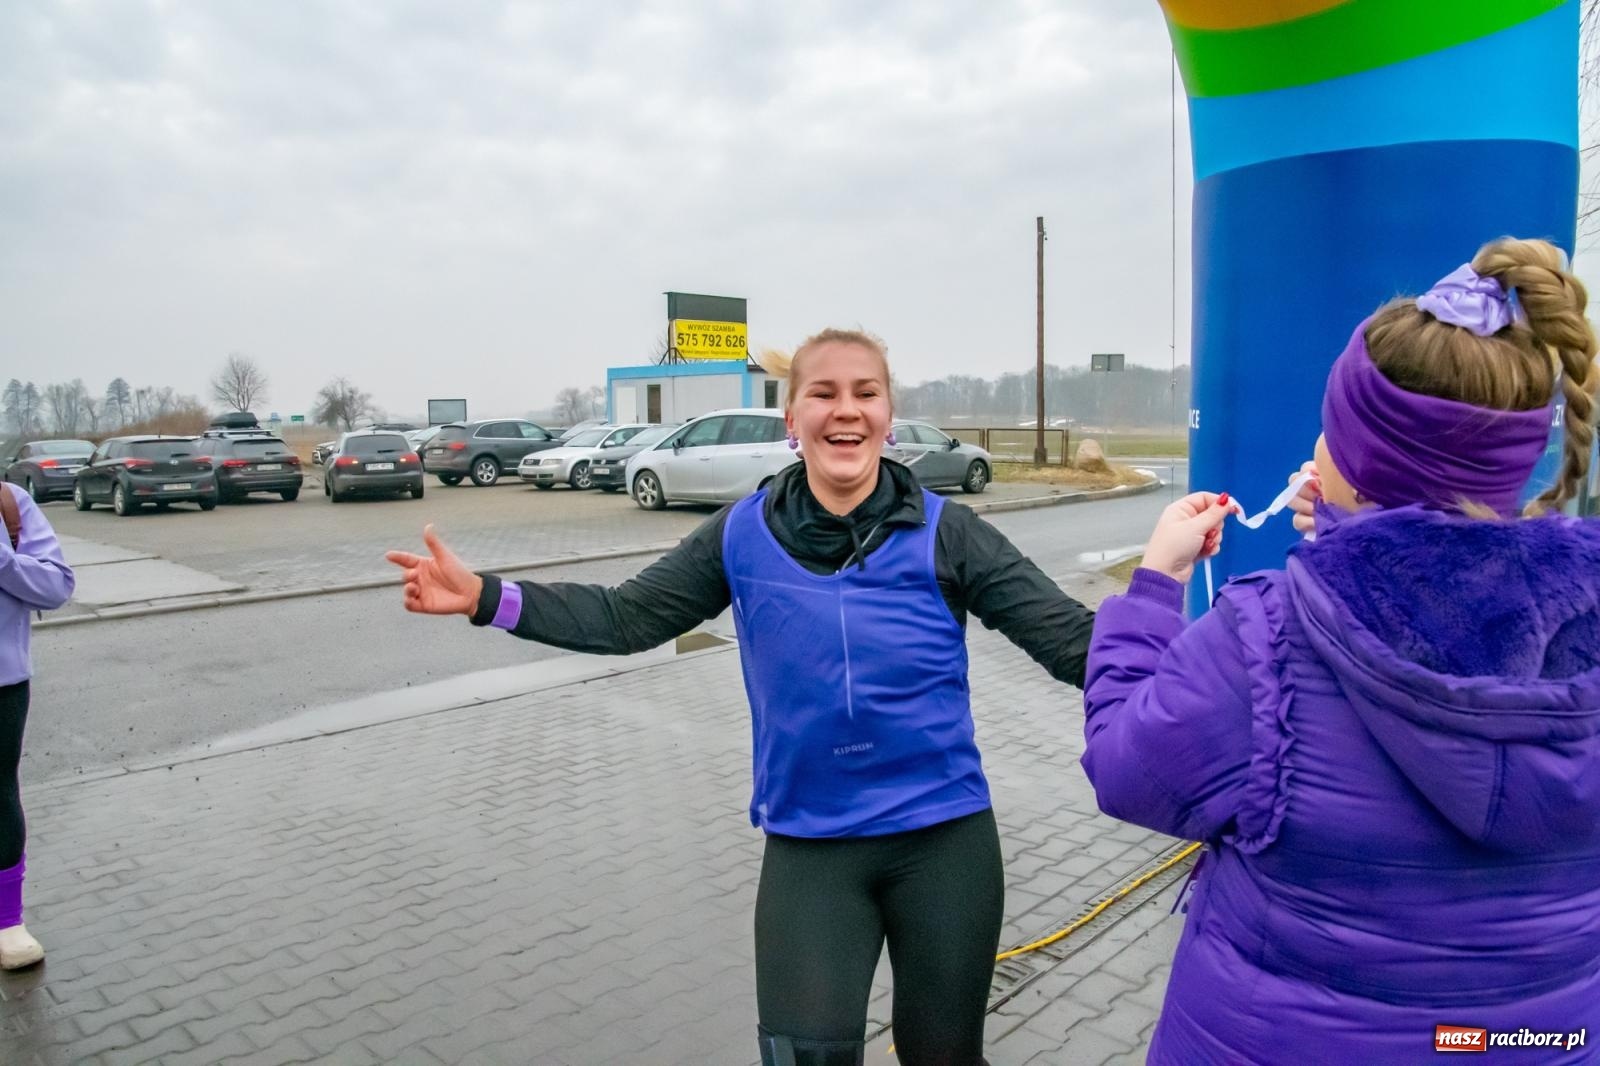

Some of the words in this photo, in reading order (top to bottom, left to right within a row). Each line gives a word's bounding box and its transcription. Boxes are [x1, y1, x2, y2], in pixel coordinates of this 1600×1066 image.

[677, 333, 698, 346] 575
[702, 334, 722, 347] 792
[725, 335, 745, 348] 626
[833, 742, 874, 756] KIPRUN
